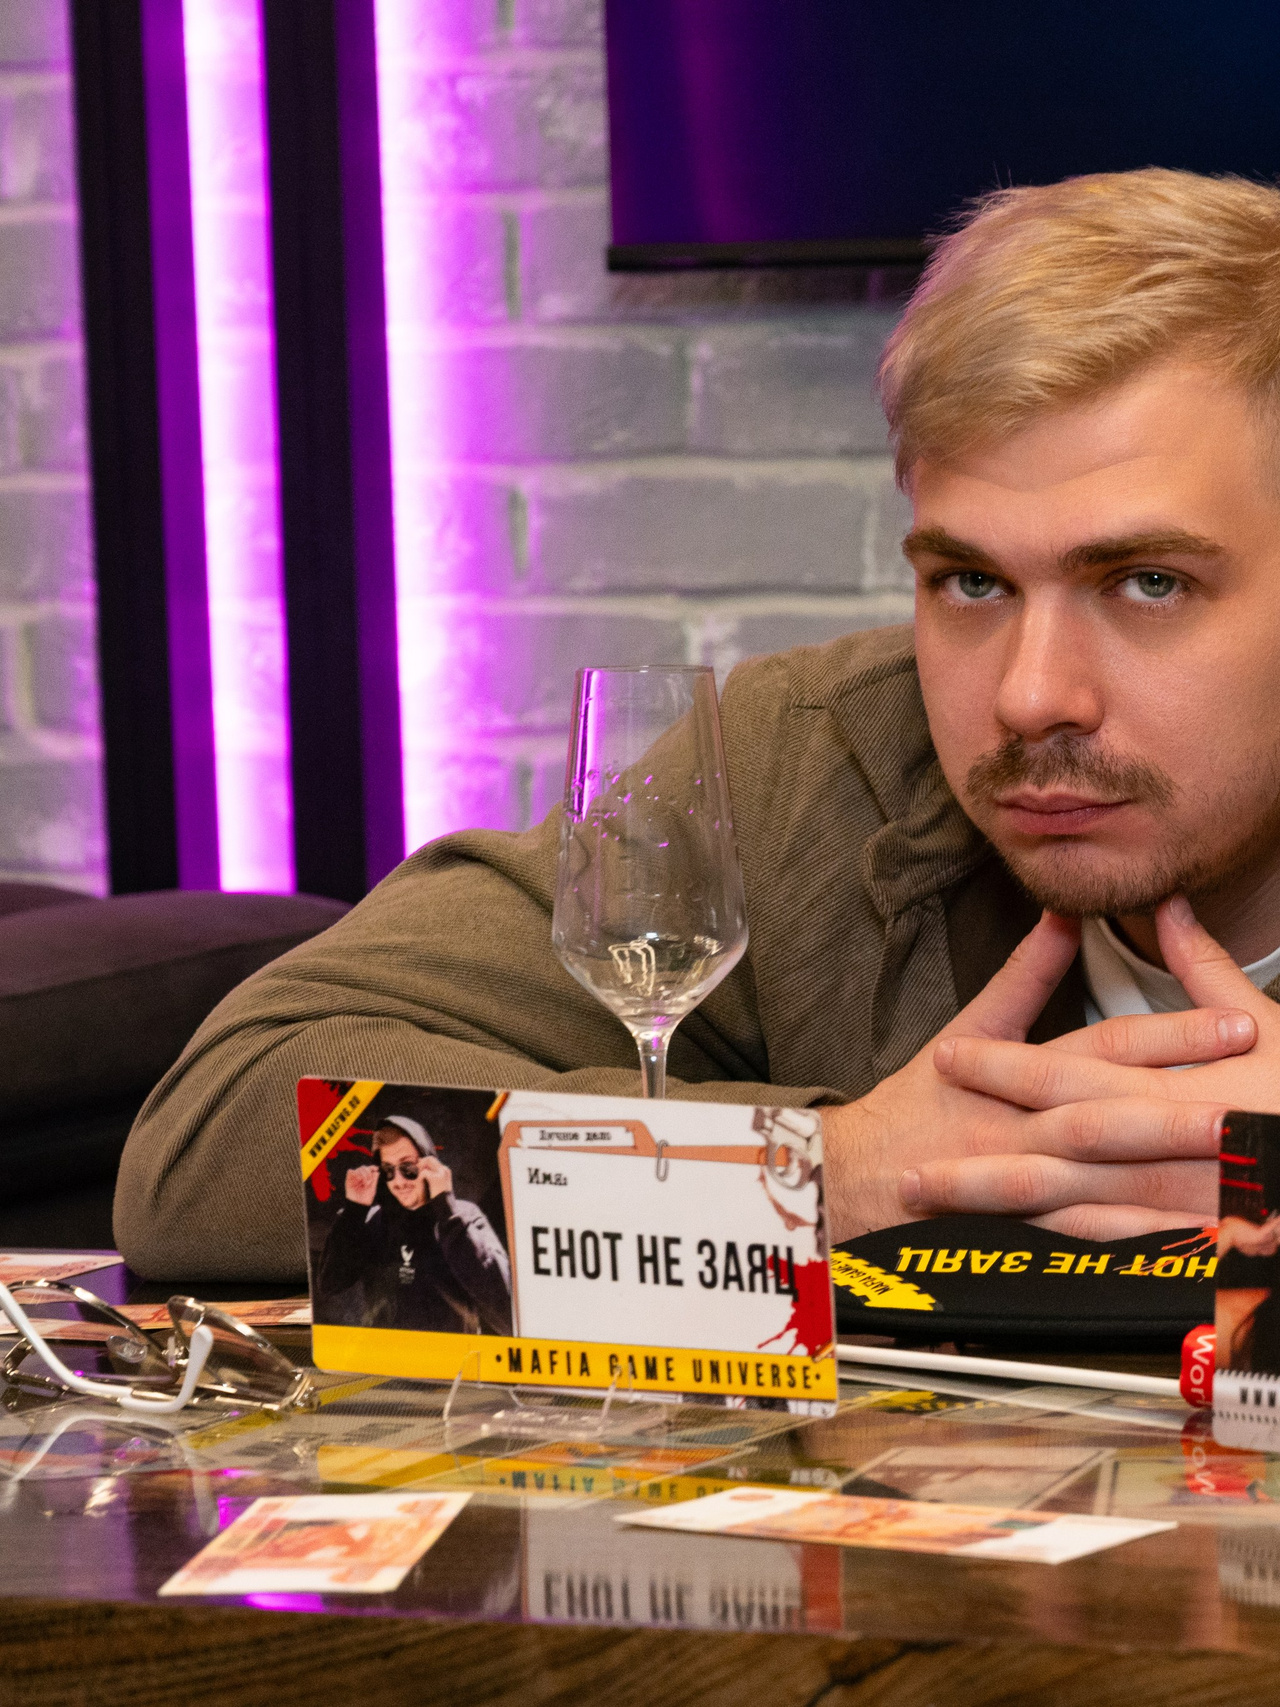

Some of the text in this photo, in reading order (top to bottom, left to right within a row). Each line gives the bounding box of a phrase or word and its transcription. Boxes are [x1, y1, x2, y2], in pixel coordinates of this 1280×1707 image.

[531, 1225, 799, 1303] ЕНОТ НЕ ЗАЯЦ
[896, 1246, 1218, 1278] НОТ НЕ ЗАЯЦ
[608, 1353, 676, 1382] GAME
